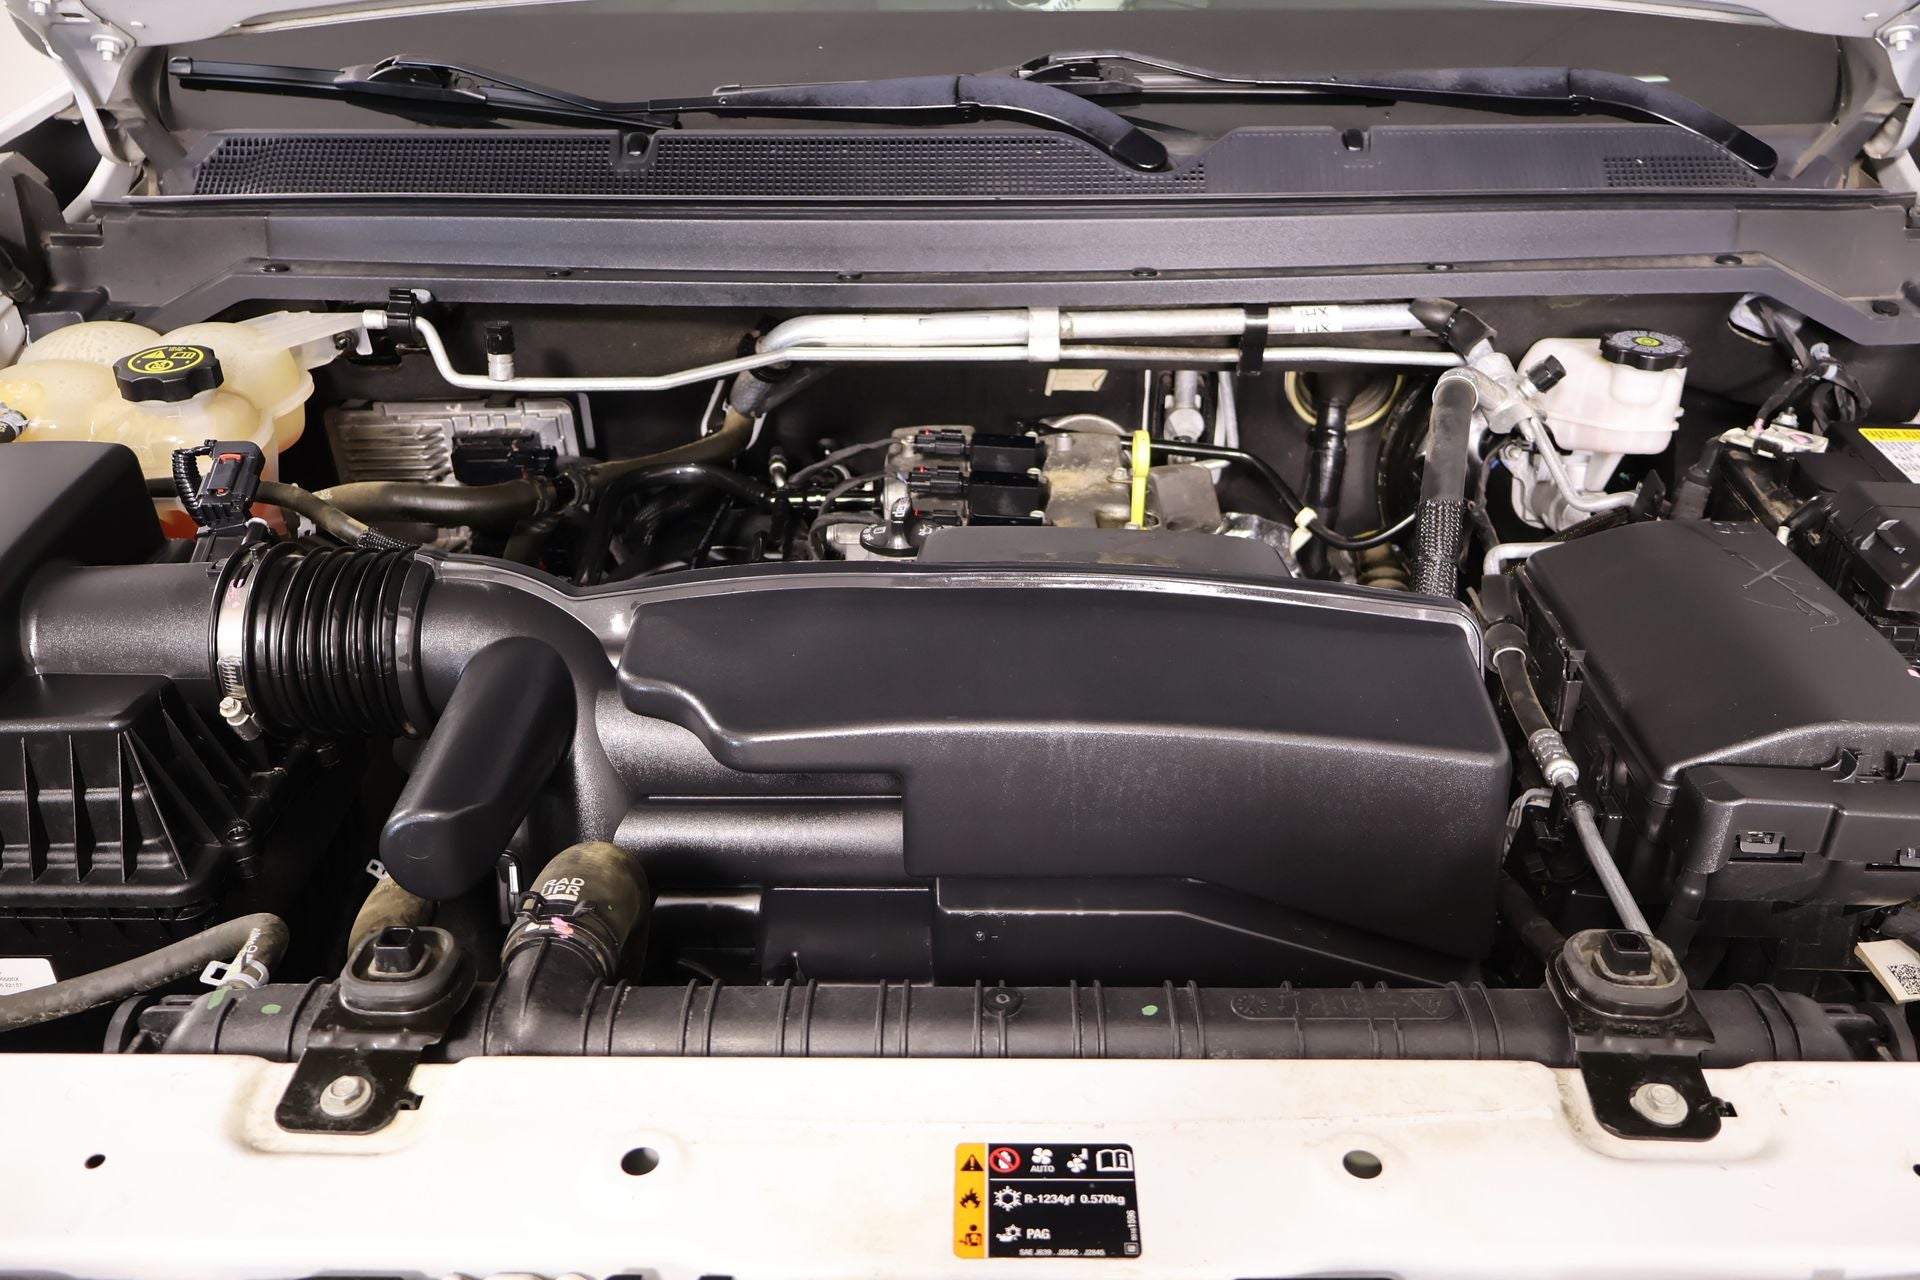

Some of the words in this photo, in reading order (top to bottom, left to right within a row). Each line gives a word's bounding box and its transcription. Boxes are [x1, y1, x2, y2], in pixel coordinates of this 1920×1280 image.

[544, 877, 585, 887] RAD
[541, 884, 581, 896] UPR
[1030, 1165, 1055, 1173] AUTO
[1024, 1193, 1075, 1206] R-1234yf
[1079, 1193, 1126, 1206] 0.570kg
[1026, 1229, 1051, 1240] PAG
[1019, 1248, 1034, 1256] SAE
